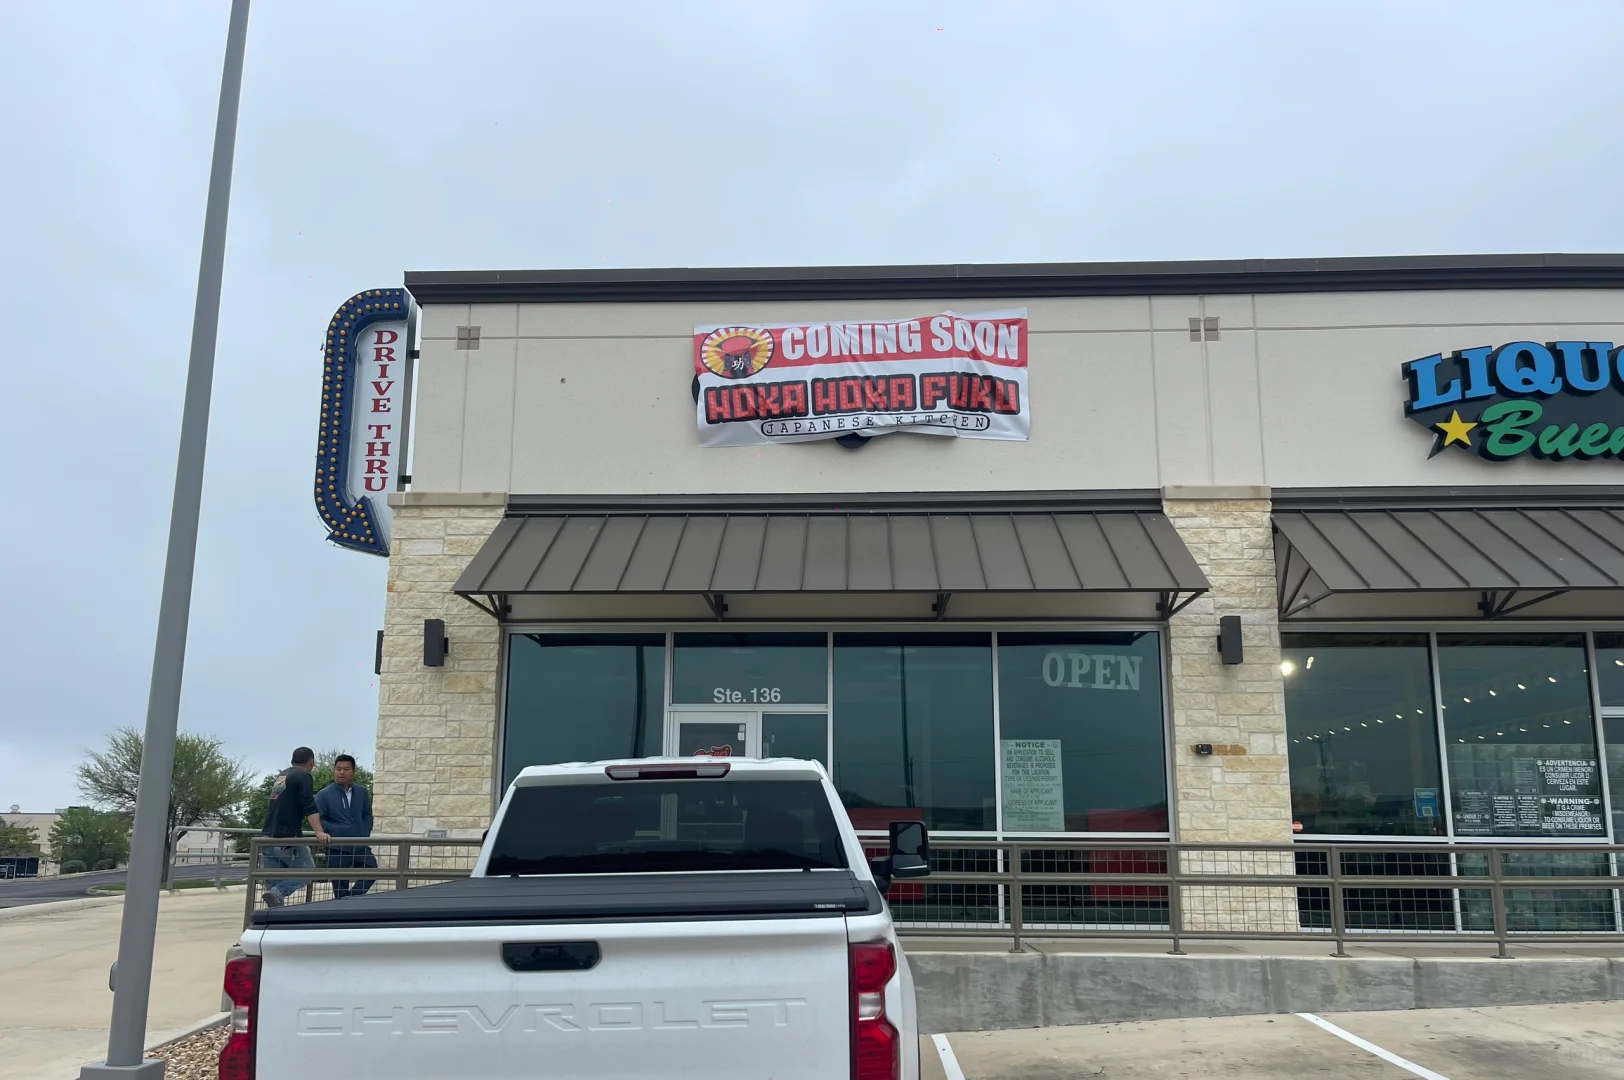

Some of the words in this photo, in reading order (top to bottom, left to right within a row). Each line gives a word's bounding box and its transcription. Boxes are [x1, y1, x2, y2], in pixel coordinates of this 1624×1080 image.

[781, 320, 922, 360] COMING
[930, 316, 1019, 360] SOON
[371, 330, 399, 412] DRIVE
[1407, 340, 1624, 411] LIQU
[706, 383, 806, 421] HOKA
[814, 377, 913, 412] HOKA
[922, 375, 1018, 411] FUKU
[766, 416, 874, 434] JAPANESE
[363, 424, 392, 492] THRU
[1043, 652, 1142, 690] OPEN
[713, 687, 747, 703] Ste.
[750, 687, 781, 703] 136
[297, 997, 807, 1036] CHEVROLET
